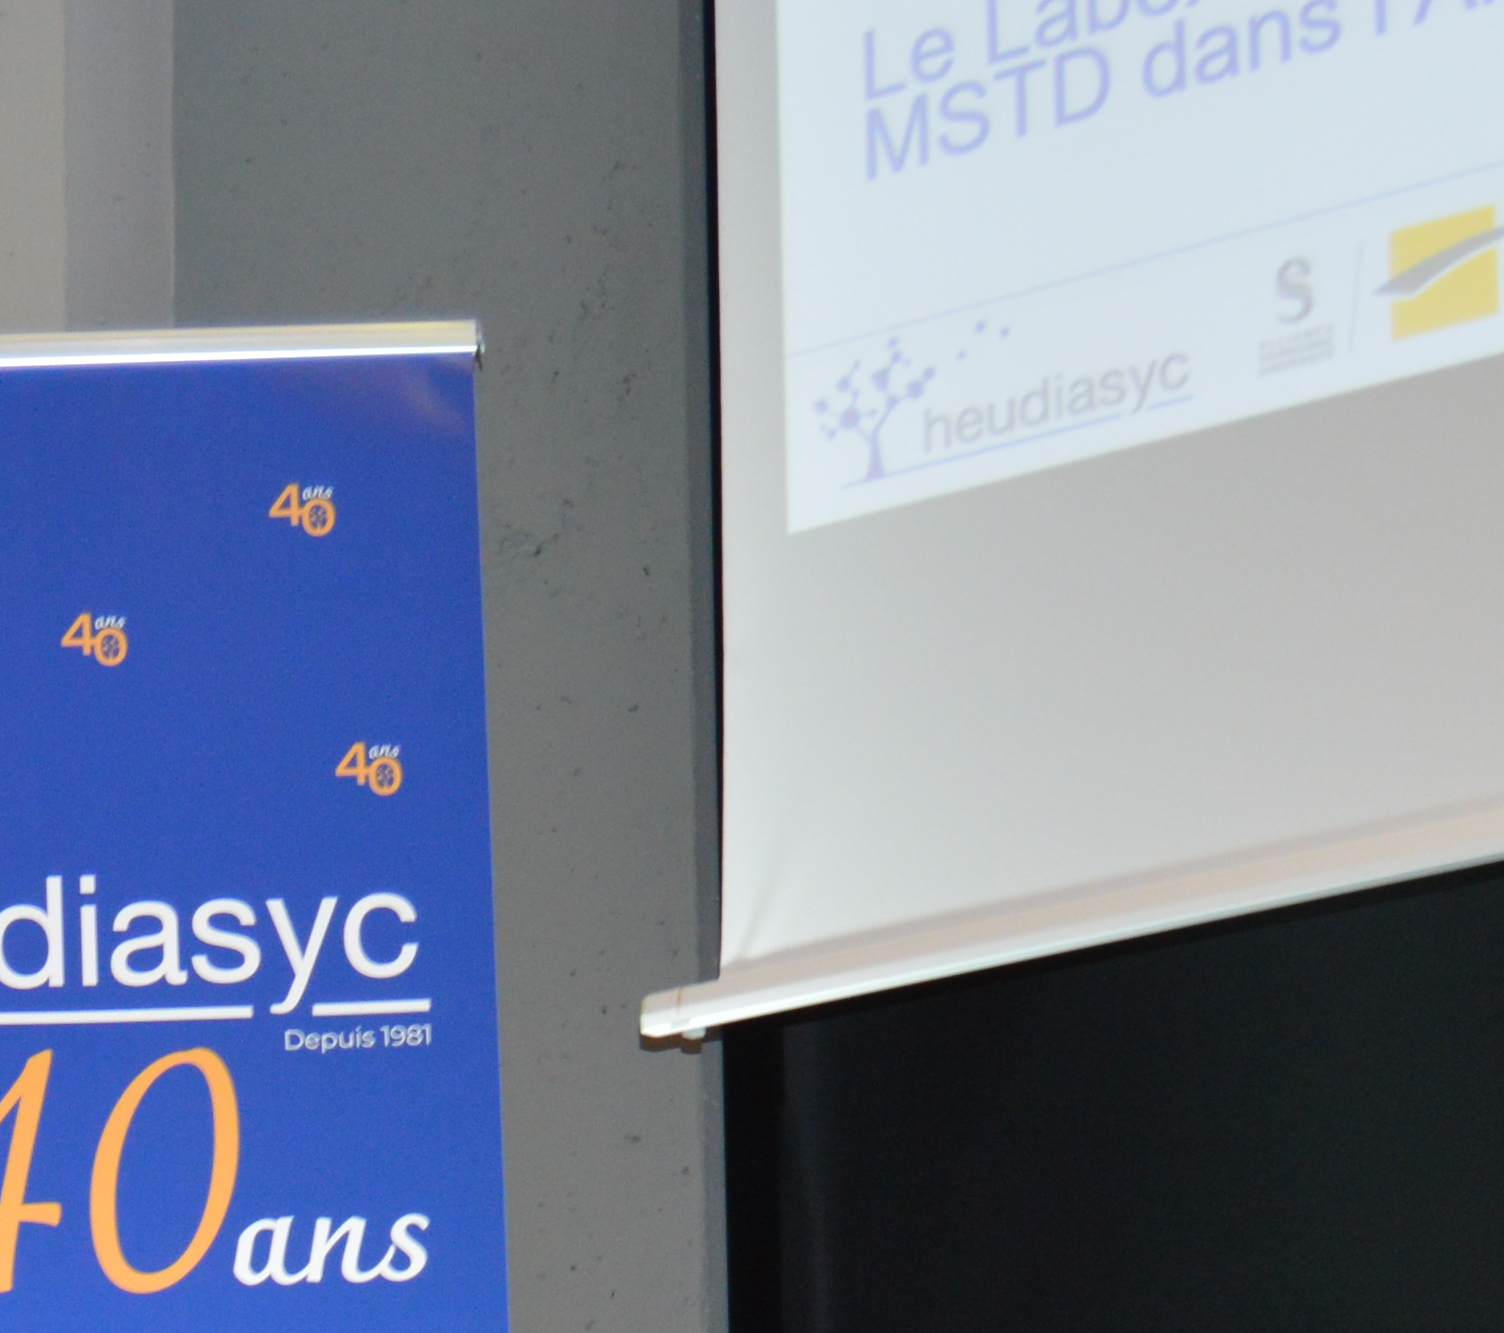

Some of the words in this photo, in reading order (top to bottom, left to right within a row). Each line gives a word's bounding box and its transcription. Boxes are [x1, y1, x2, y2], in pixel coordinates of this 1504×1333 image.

[863, 24, 954, 101] Le
[865, 45, 1112, 182] MSTD
[1143, 18, 1343, 99] dans
[923, 352, 1191, 454] heudiasyc
[269, 484, 335, 536] 40
[62, 614, 127, 666] 40
[336, 743, 402, 796] 40
[284, 1028, 373, 1056] Depuis
[379, 1024, 432, 1048] 1981
[232, 1209, 430, 1286] ans
